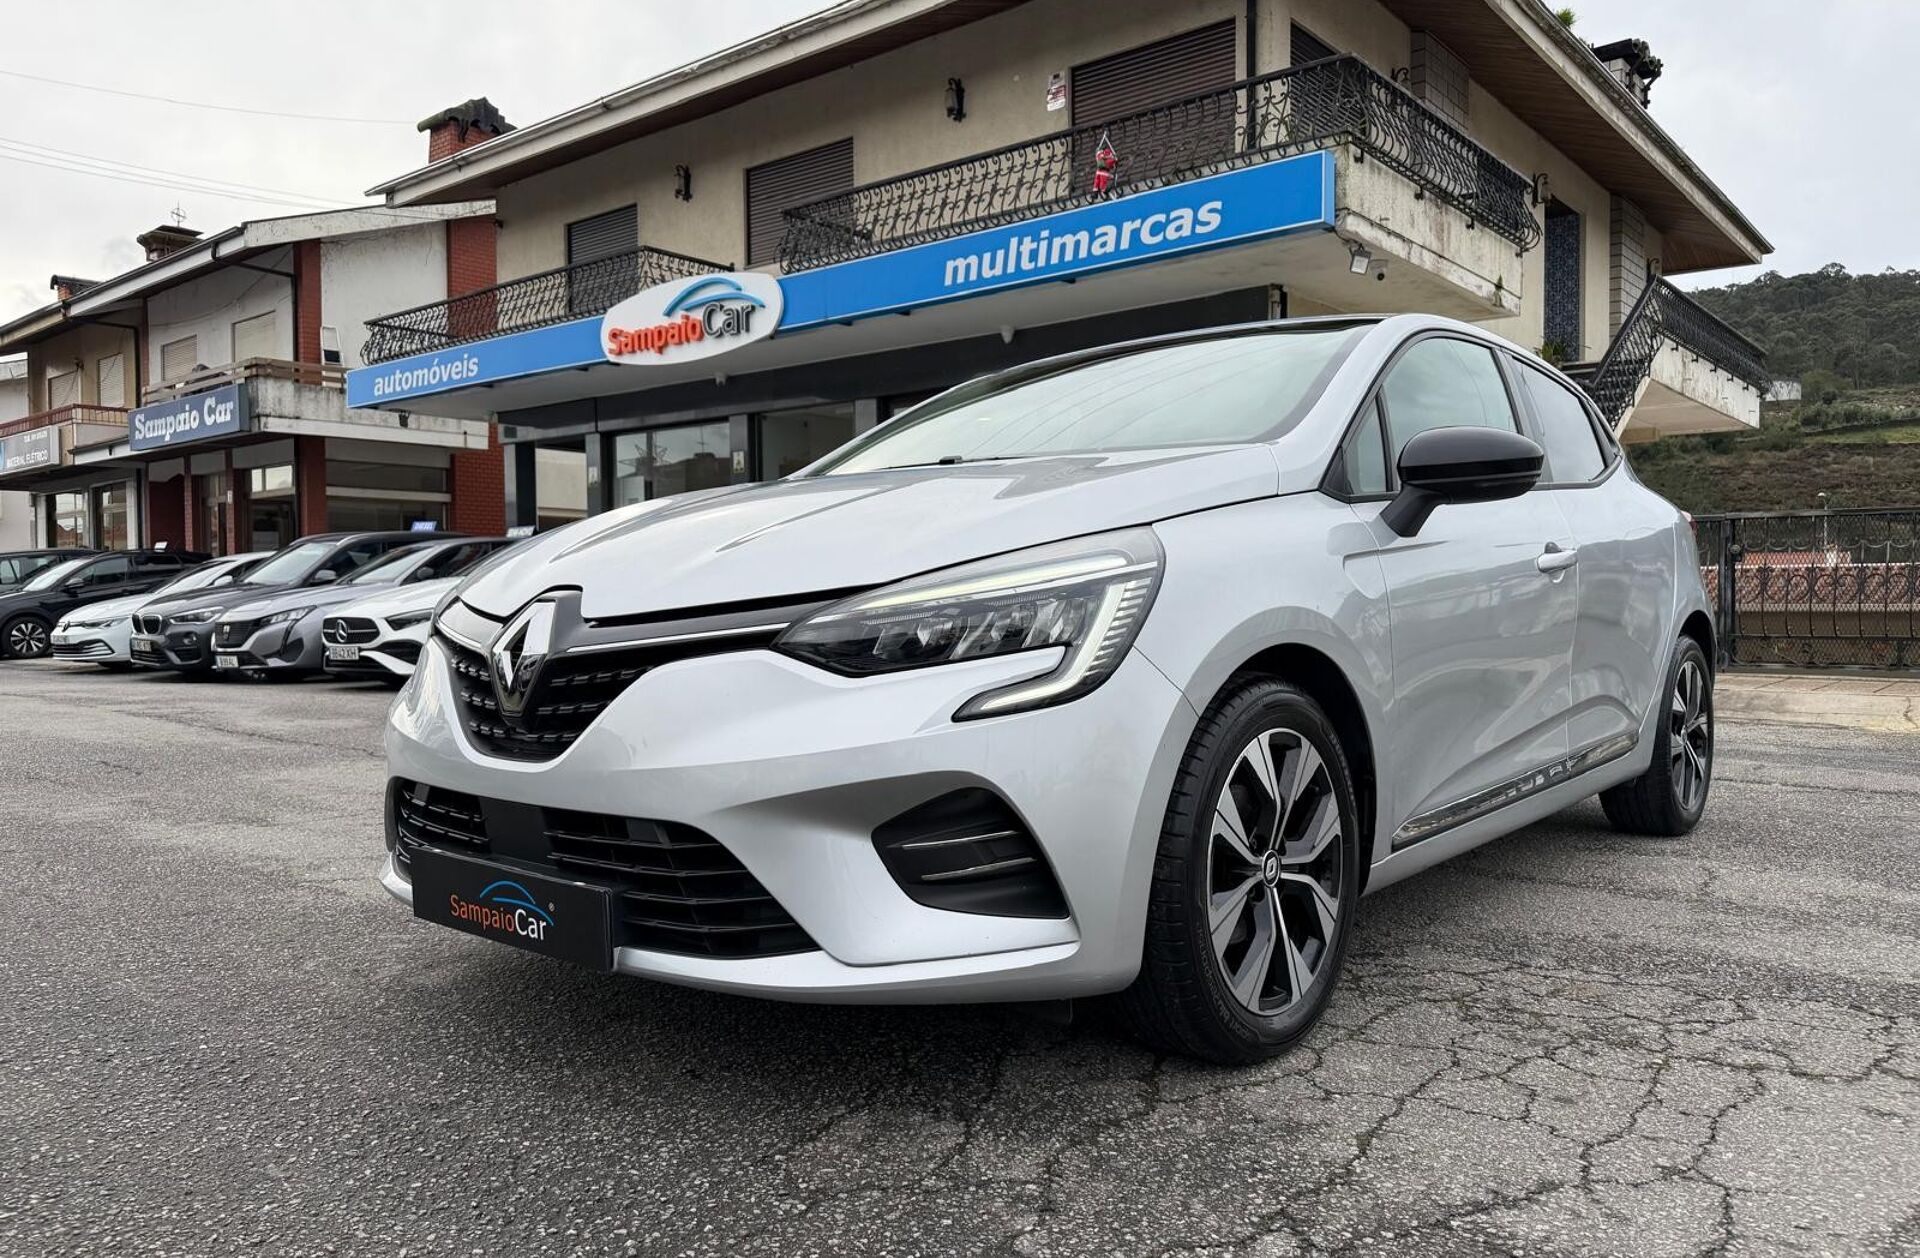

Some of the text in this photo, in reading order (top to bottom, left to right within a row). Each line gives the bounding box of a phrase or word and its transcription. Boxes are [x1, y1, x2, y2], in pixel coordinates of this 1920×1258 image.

[944, 201, 1223, 287] multimarcas
[607, 301, 757, 357] SampaioCar
[373, 353, 479, 397] automóveis
[135, 396, 234, 441] Sampaio Car
[449, 893, 547, 941] SampaioCar
